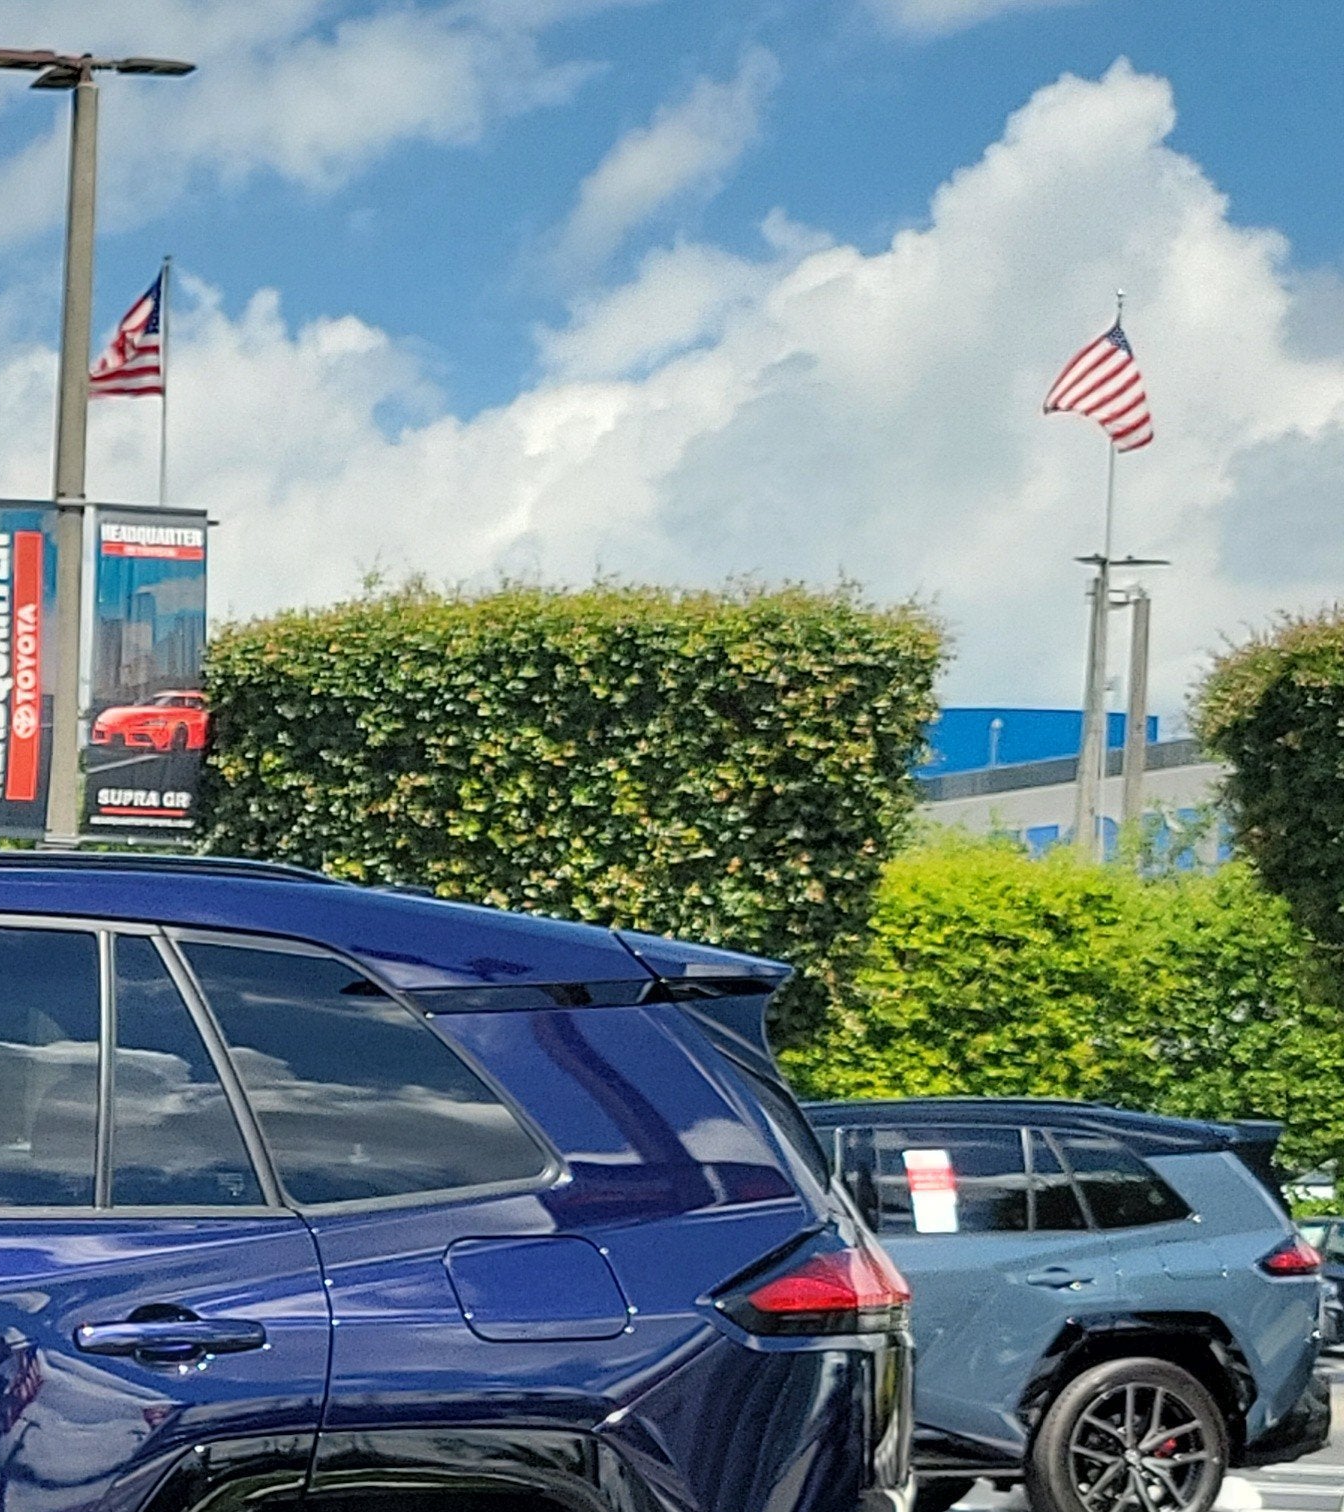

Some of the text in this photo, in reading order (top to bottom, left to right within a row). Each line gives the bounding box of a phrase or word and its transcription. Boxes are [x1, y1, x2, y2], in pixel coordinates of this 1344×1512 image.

[17, 603, 36, 704] TOYOTA
[97, 788, 192, 808] SUPRA GR
